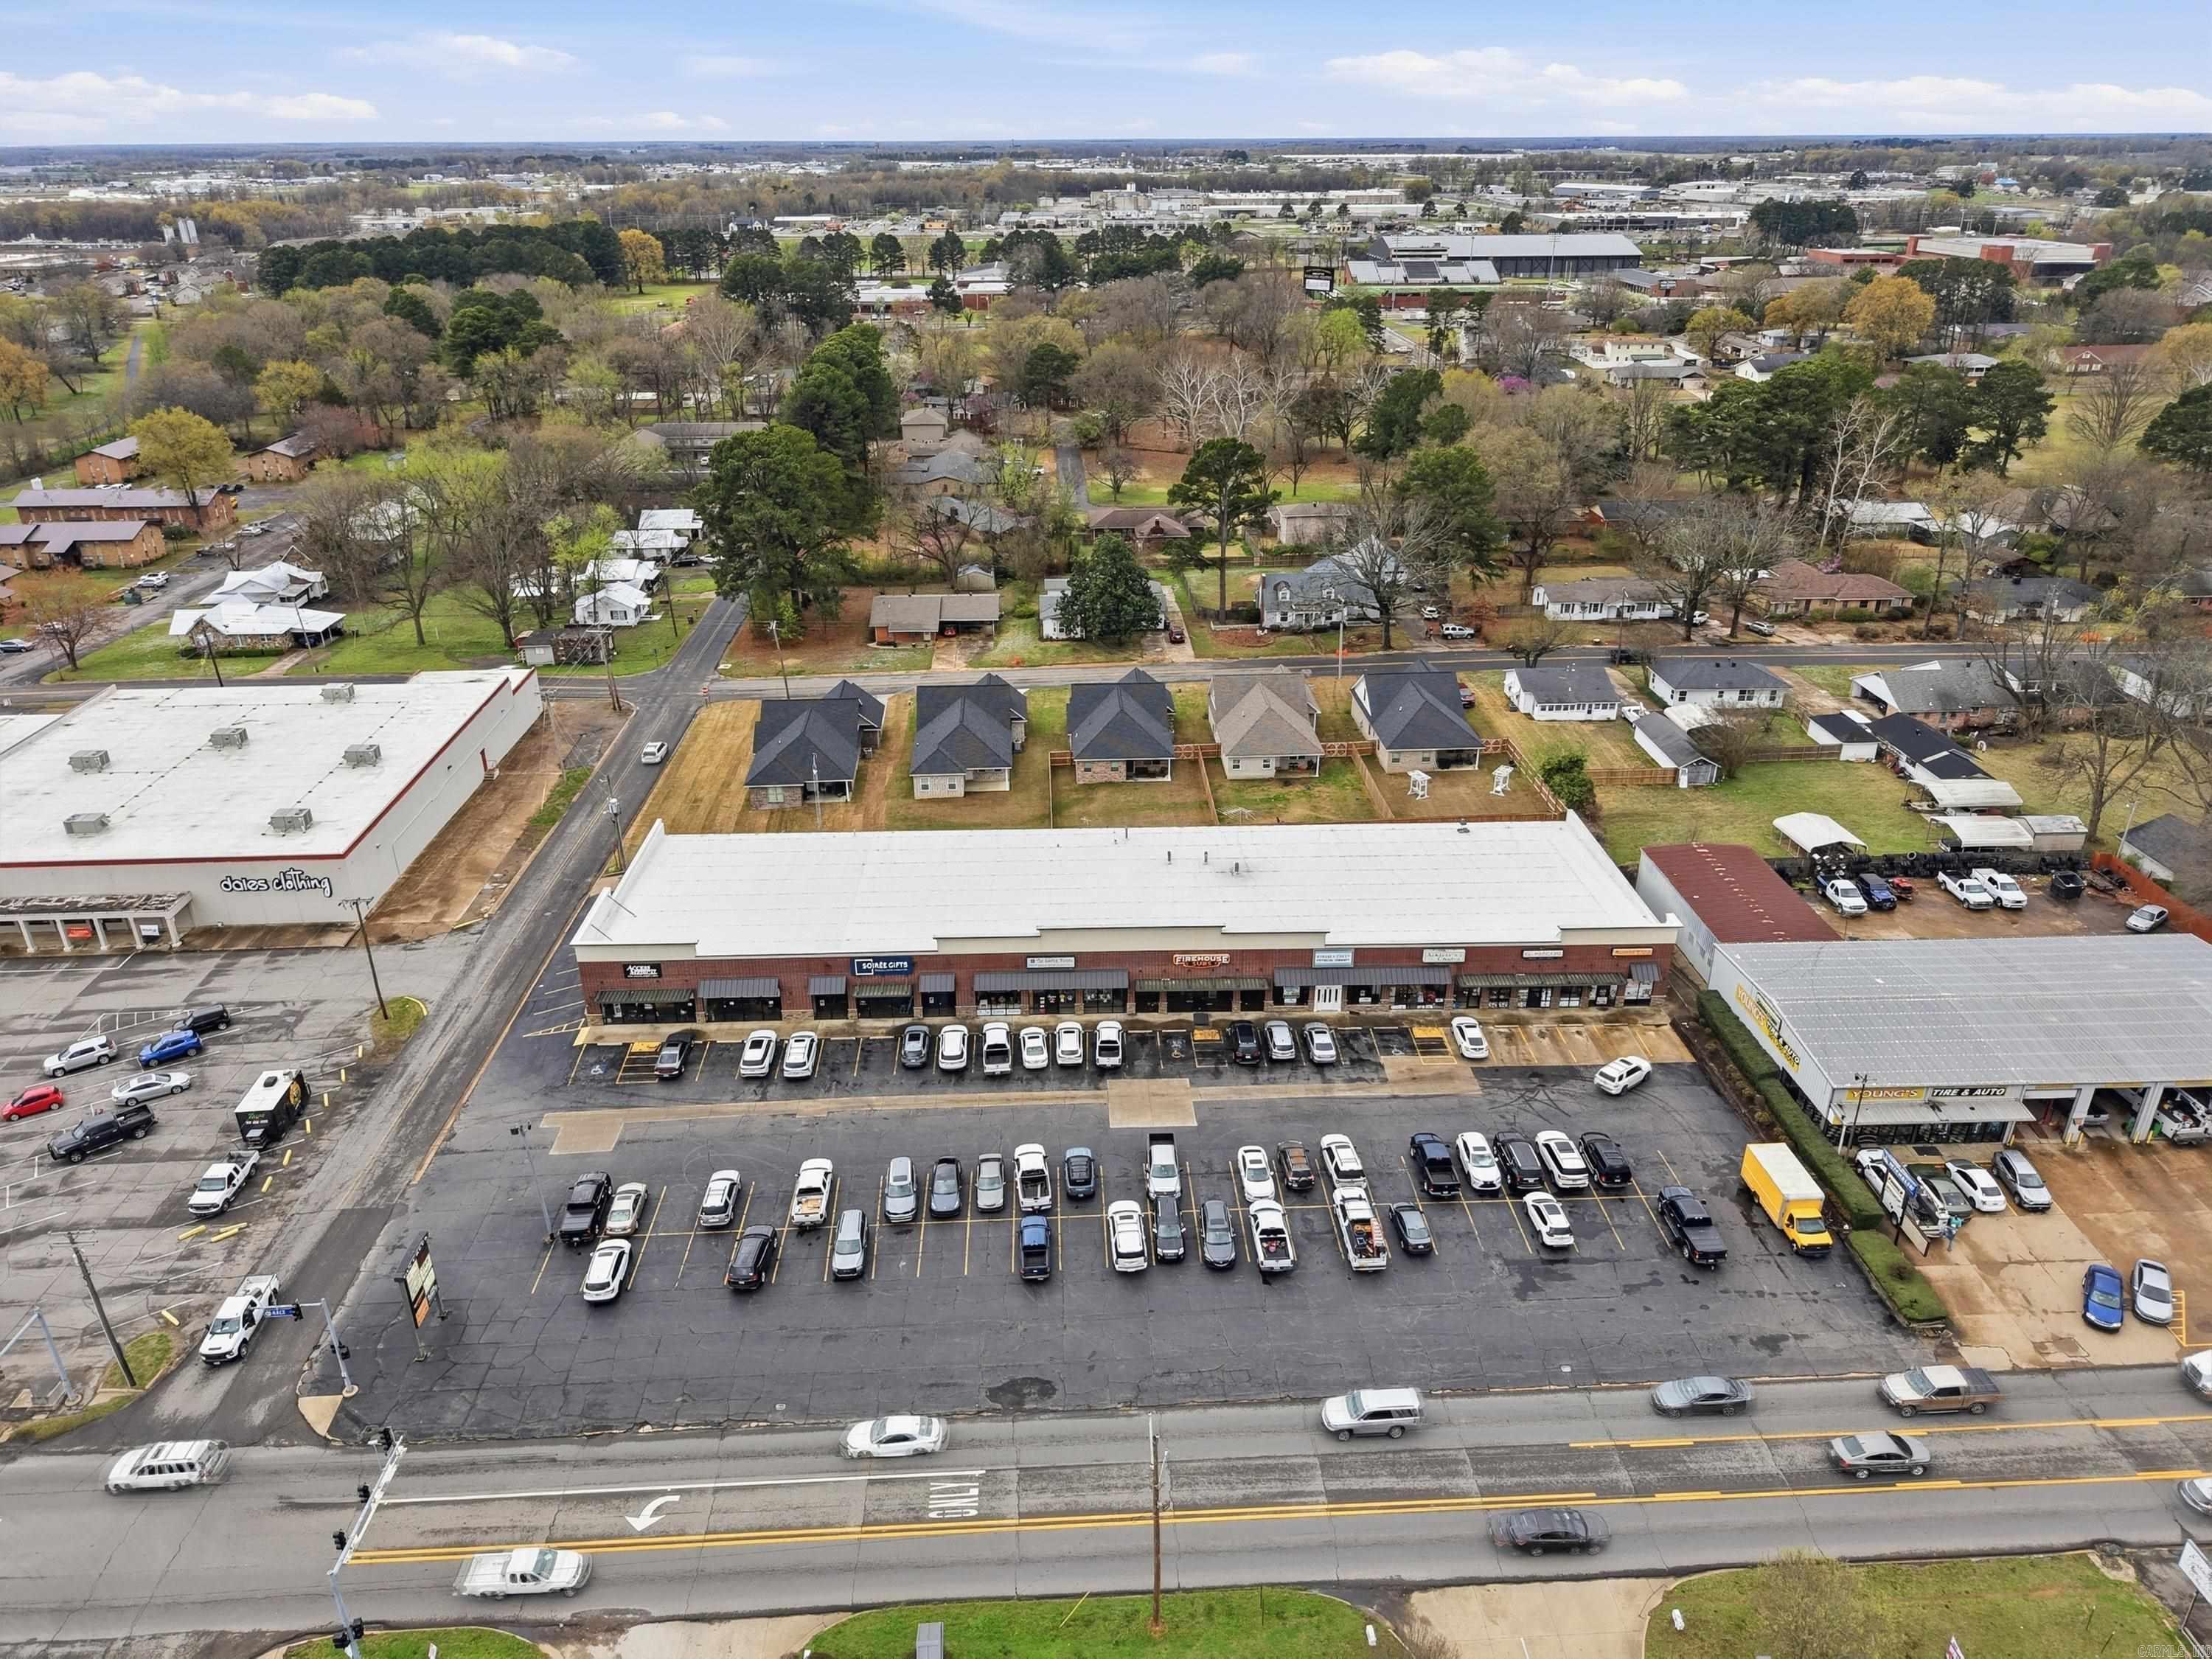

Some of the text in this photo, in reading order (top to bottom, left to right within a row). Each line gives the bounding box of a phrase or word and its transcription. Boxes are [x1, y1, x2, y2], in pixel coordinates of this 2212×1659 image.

[220, 867, 333, 898] dales clothing
[1176, 956, 1228, 964] FIREHOUSE
[1784, 1044, 1800, 1063] AUTO
[1852, 1090, 1918, 1098] YOUNG'S
[1972, 1088, 2006, 1096] AUTO
[928, 1482, 979, 1518] ONLY
